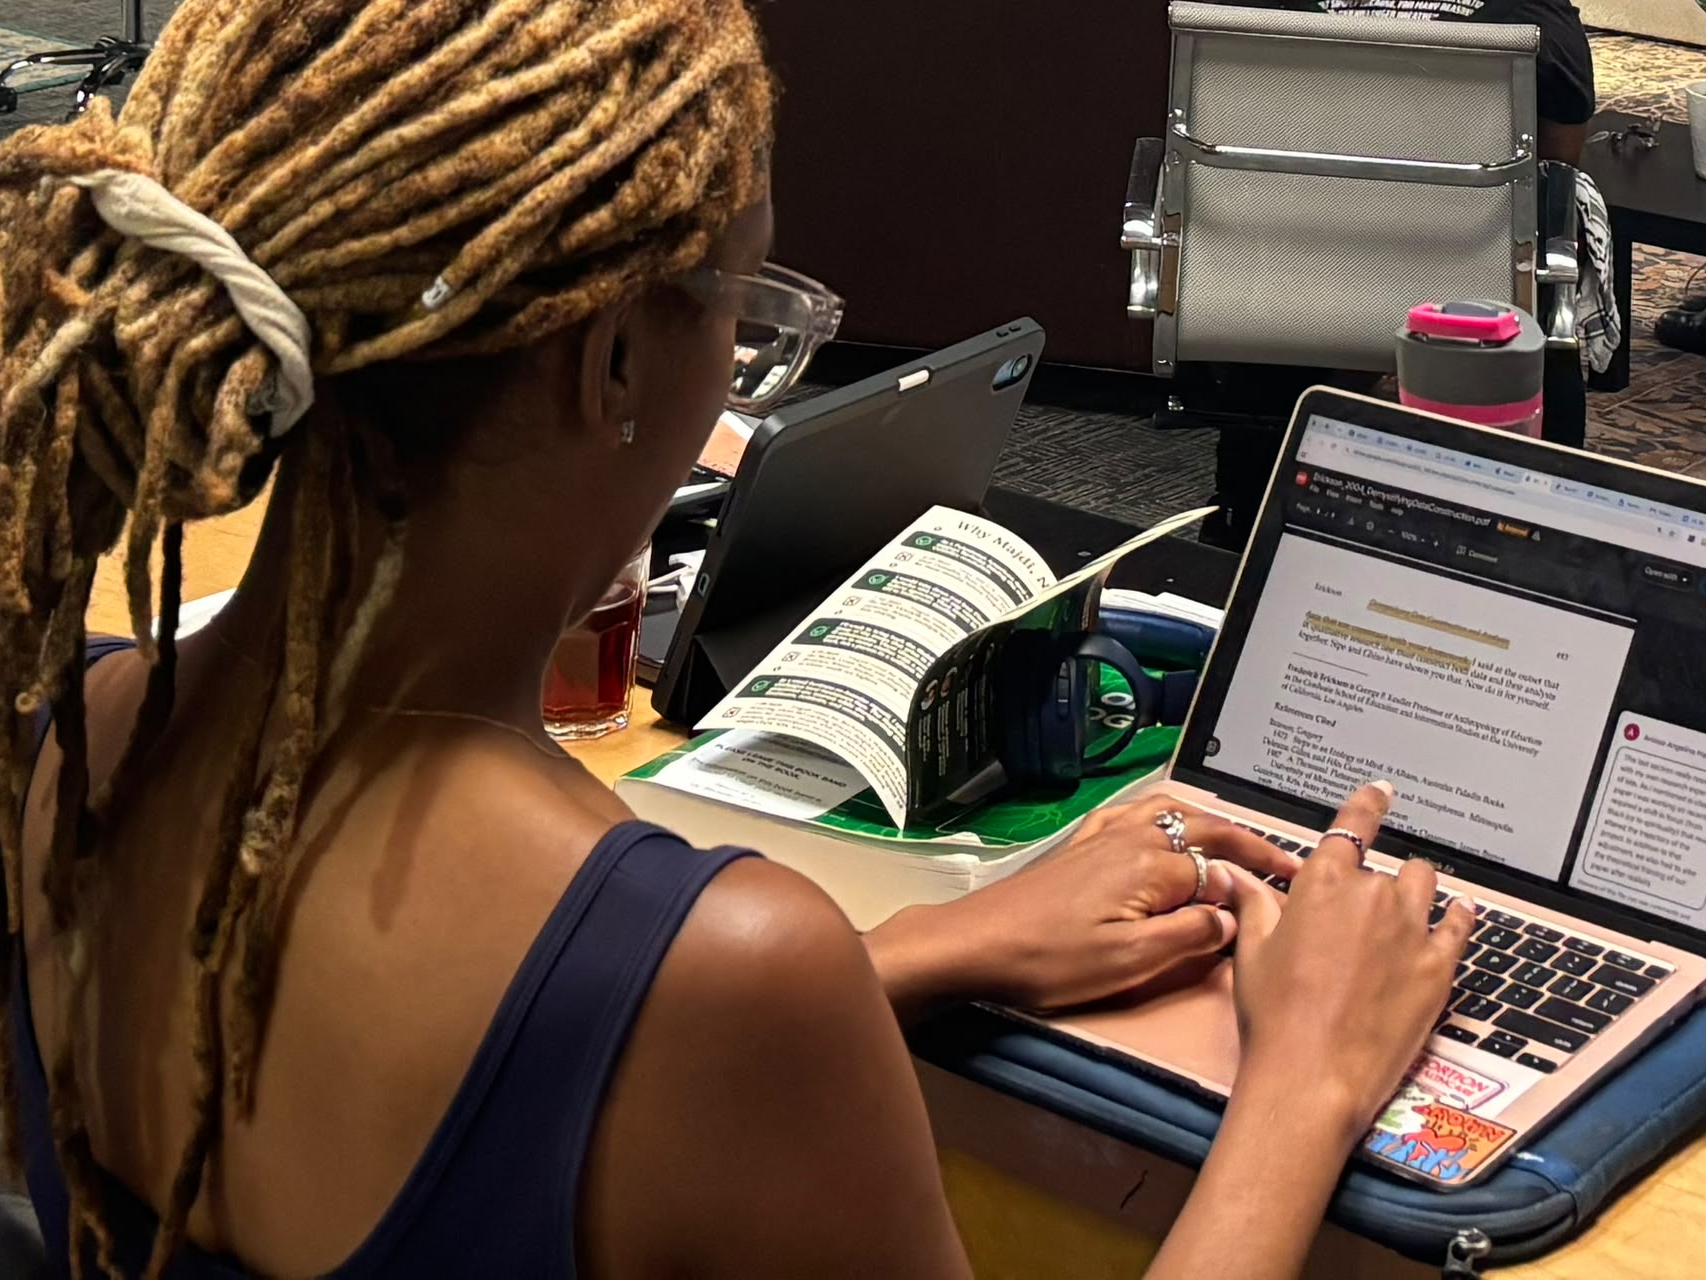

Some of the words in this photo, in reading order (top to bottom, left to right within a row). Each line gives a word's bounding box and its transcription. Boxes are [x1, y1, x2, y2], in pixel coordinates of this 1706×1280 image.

[958, 521, 992, 540] Why
[993, 536, 1035, 574] Majdi,
[1425, 1059, 1490, 1093] ORTION
